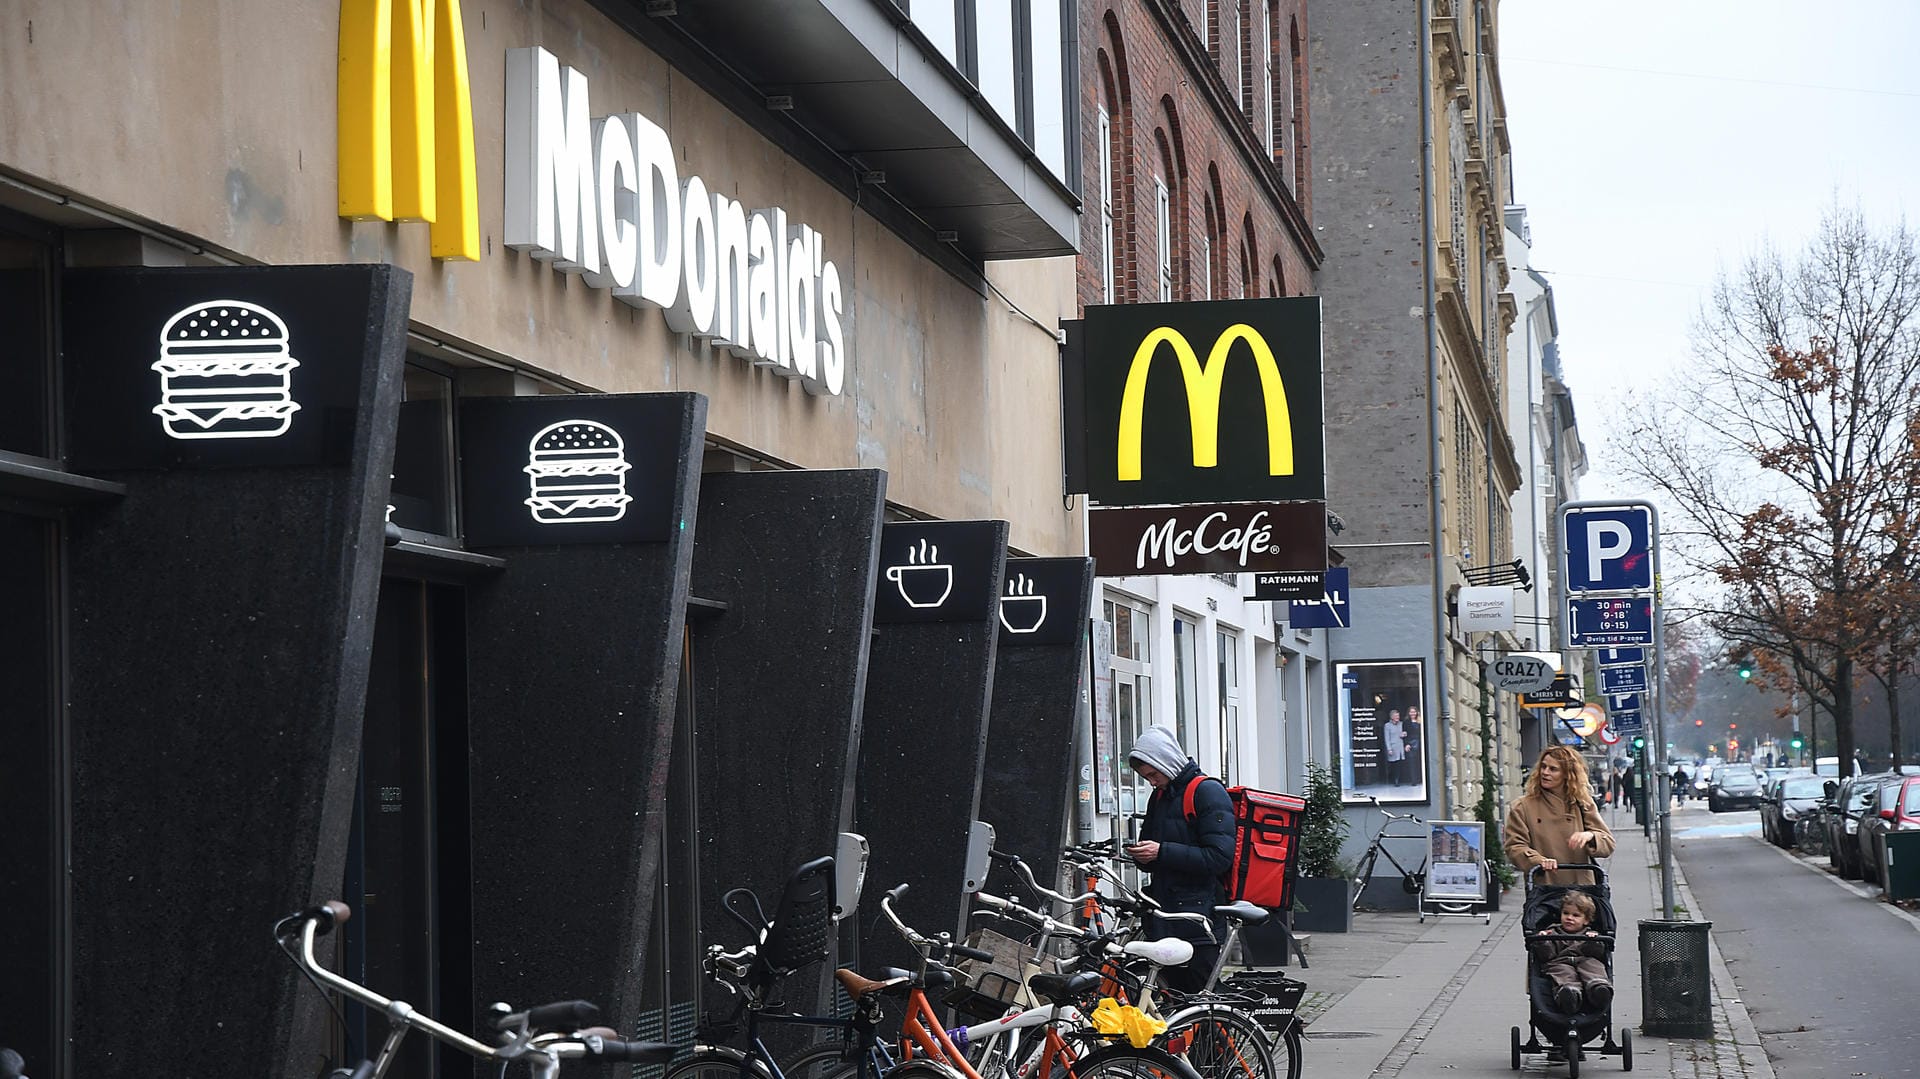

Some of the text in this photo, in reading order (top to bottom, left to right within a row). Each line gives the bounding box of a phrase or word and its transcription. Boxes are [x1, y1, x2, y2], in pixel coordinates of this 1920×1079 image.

[505, 45, 846, 396] McDonald's
[1586, 520, 1632, 582] P
[1260, 575, 1319, 585] RATHMANN
[1466, 600, 1504, 608] Begravelse
[1597, 601, 1631, 610] 30 min
[1603, 611, 1625, 619] 9-18
[1600, 621, 1629, 630] (9-15)
[1495, 662, 1547, 677] CRAZY
[1500, 677, 1540, 688] Company
